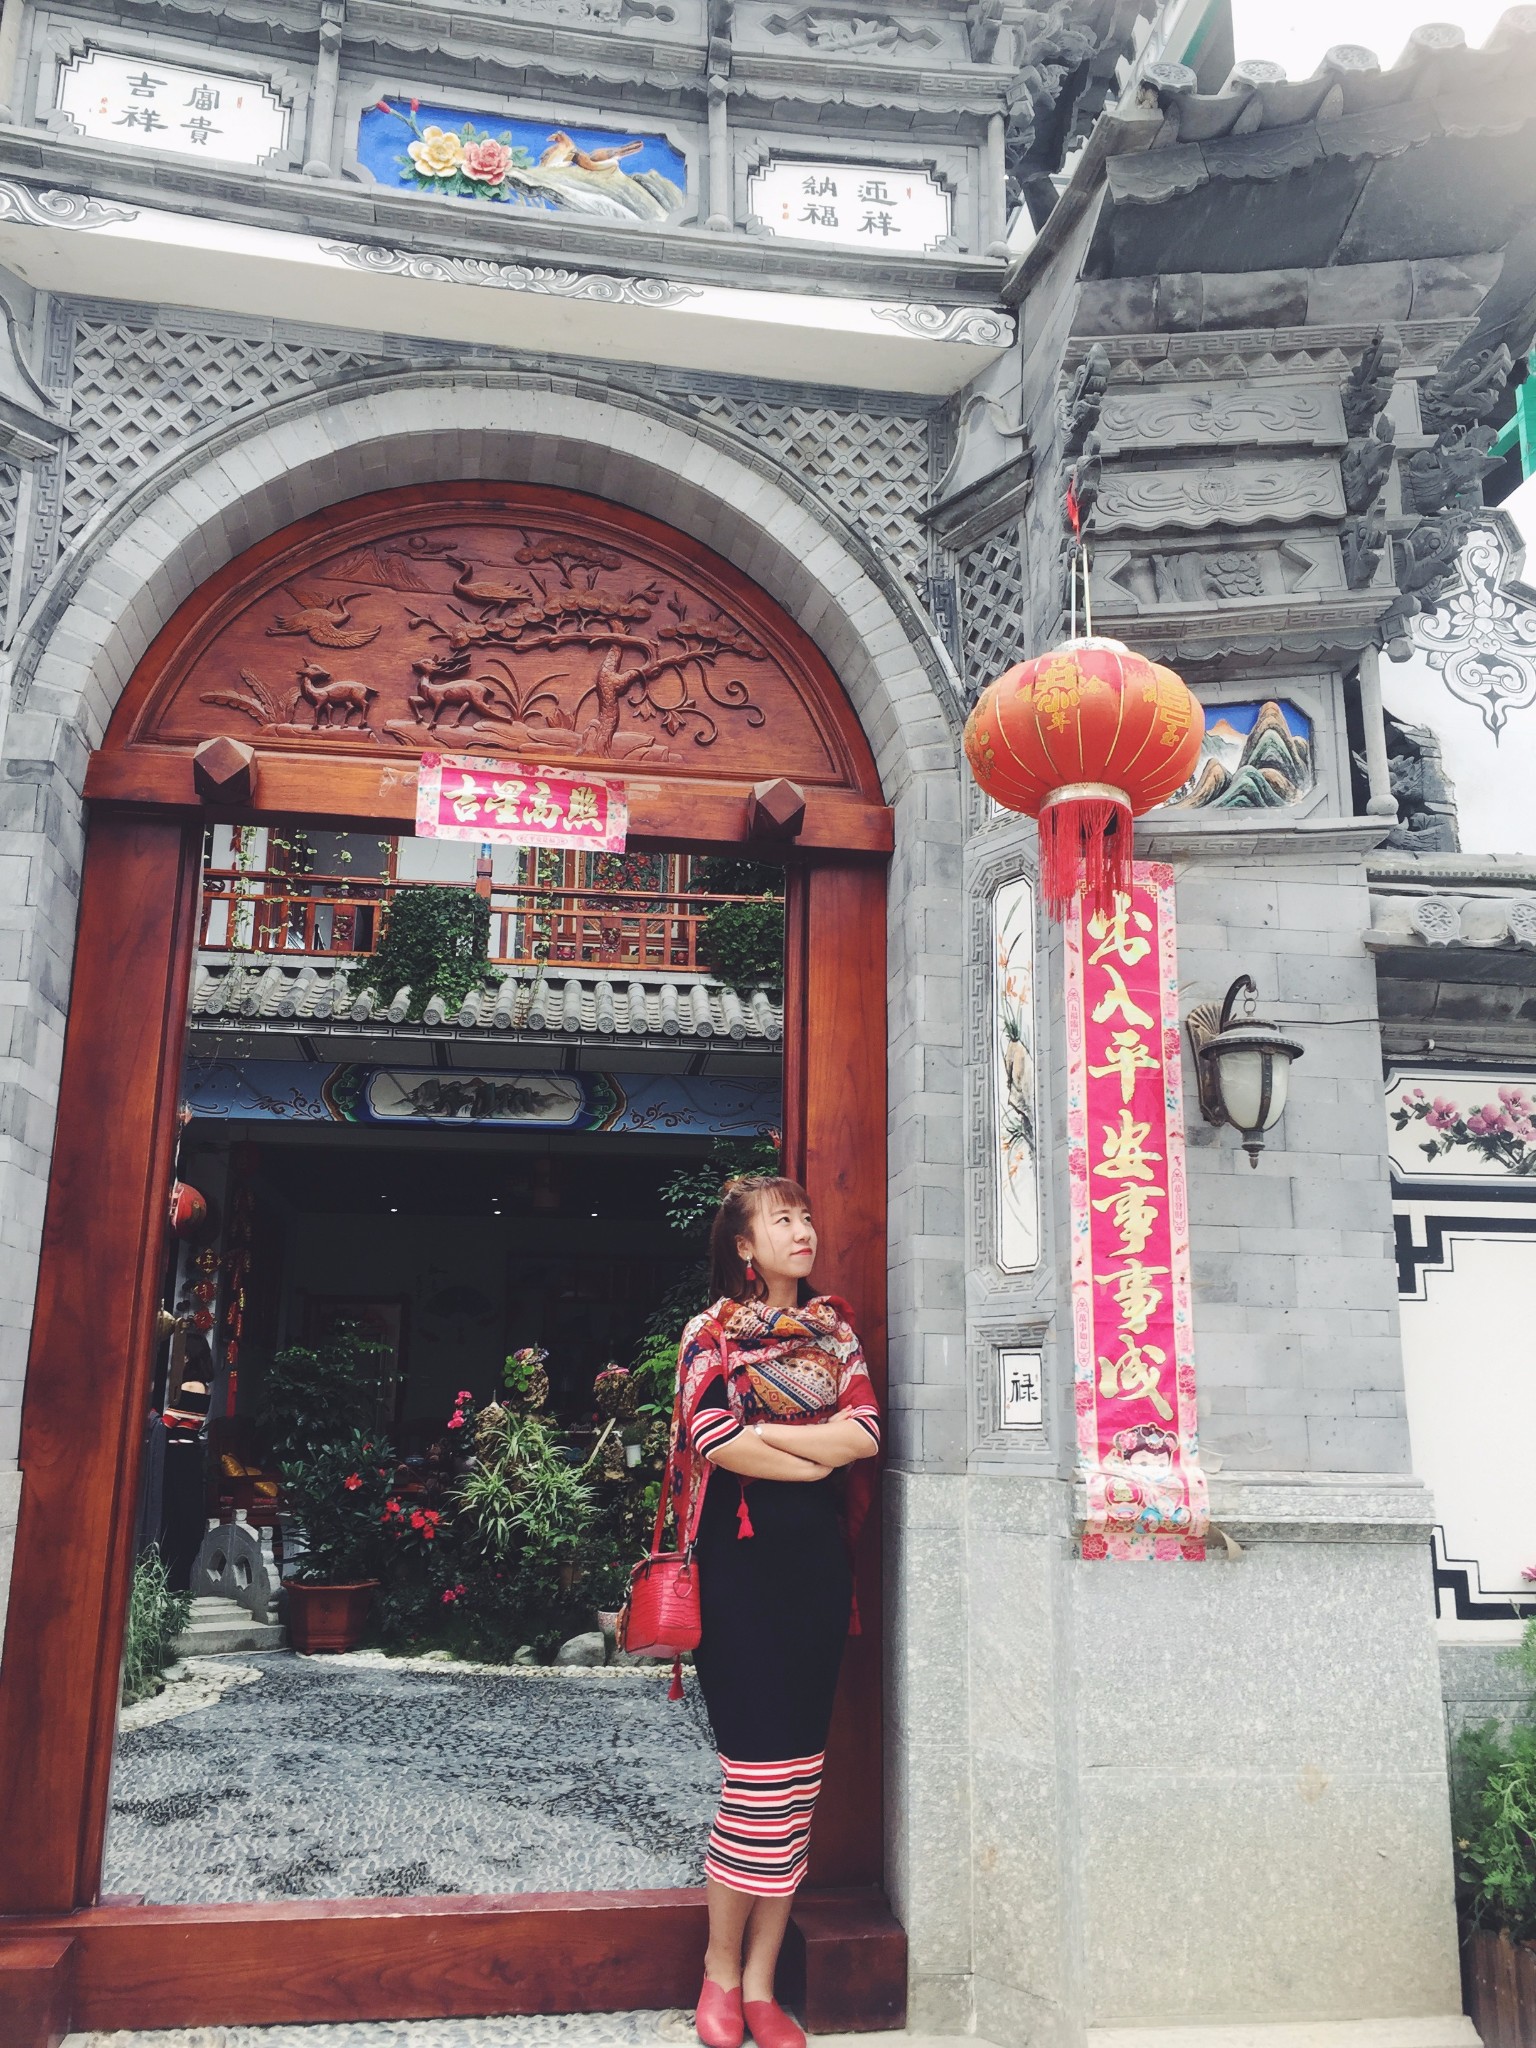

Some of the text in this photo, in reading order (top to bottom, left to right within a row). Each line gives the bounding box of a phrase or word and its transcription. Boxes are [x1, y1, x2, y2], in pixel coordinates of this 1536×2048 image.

[443, 773, 603, 832] 吉星高照
[1010, 1371, 1039, 1403] 禄
